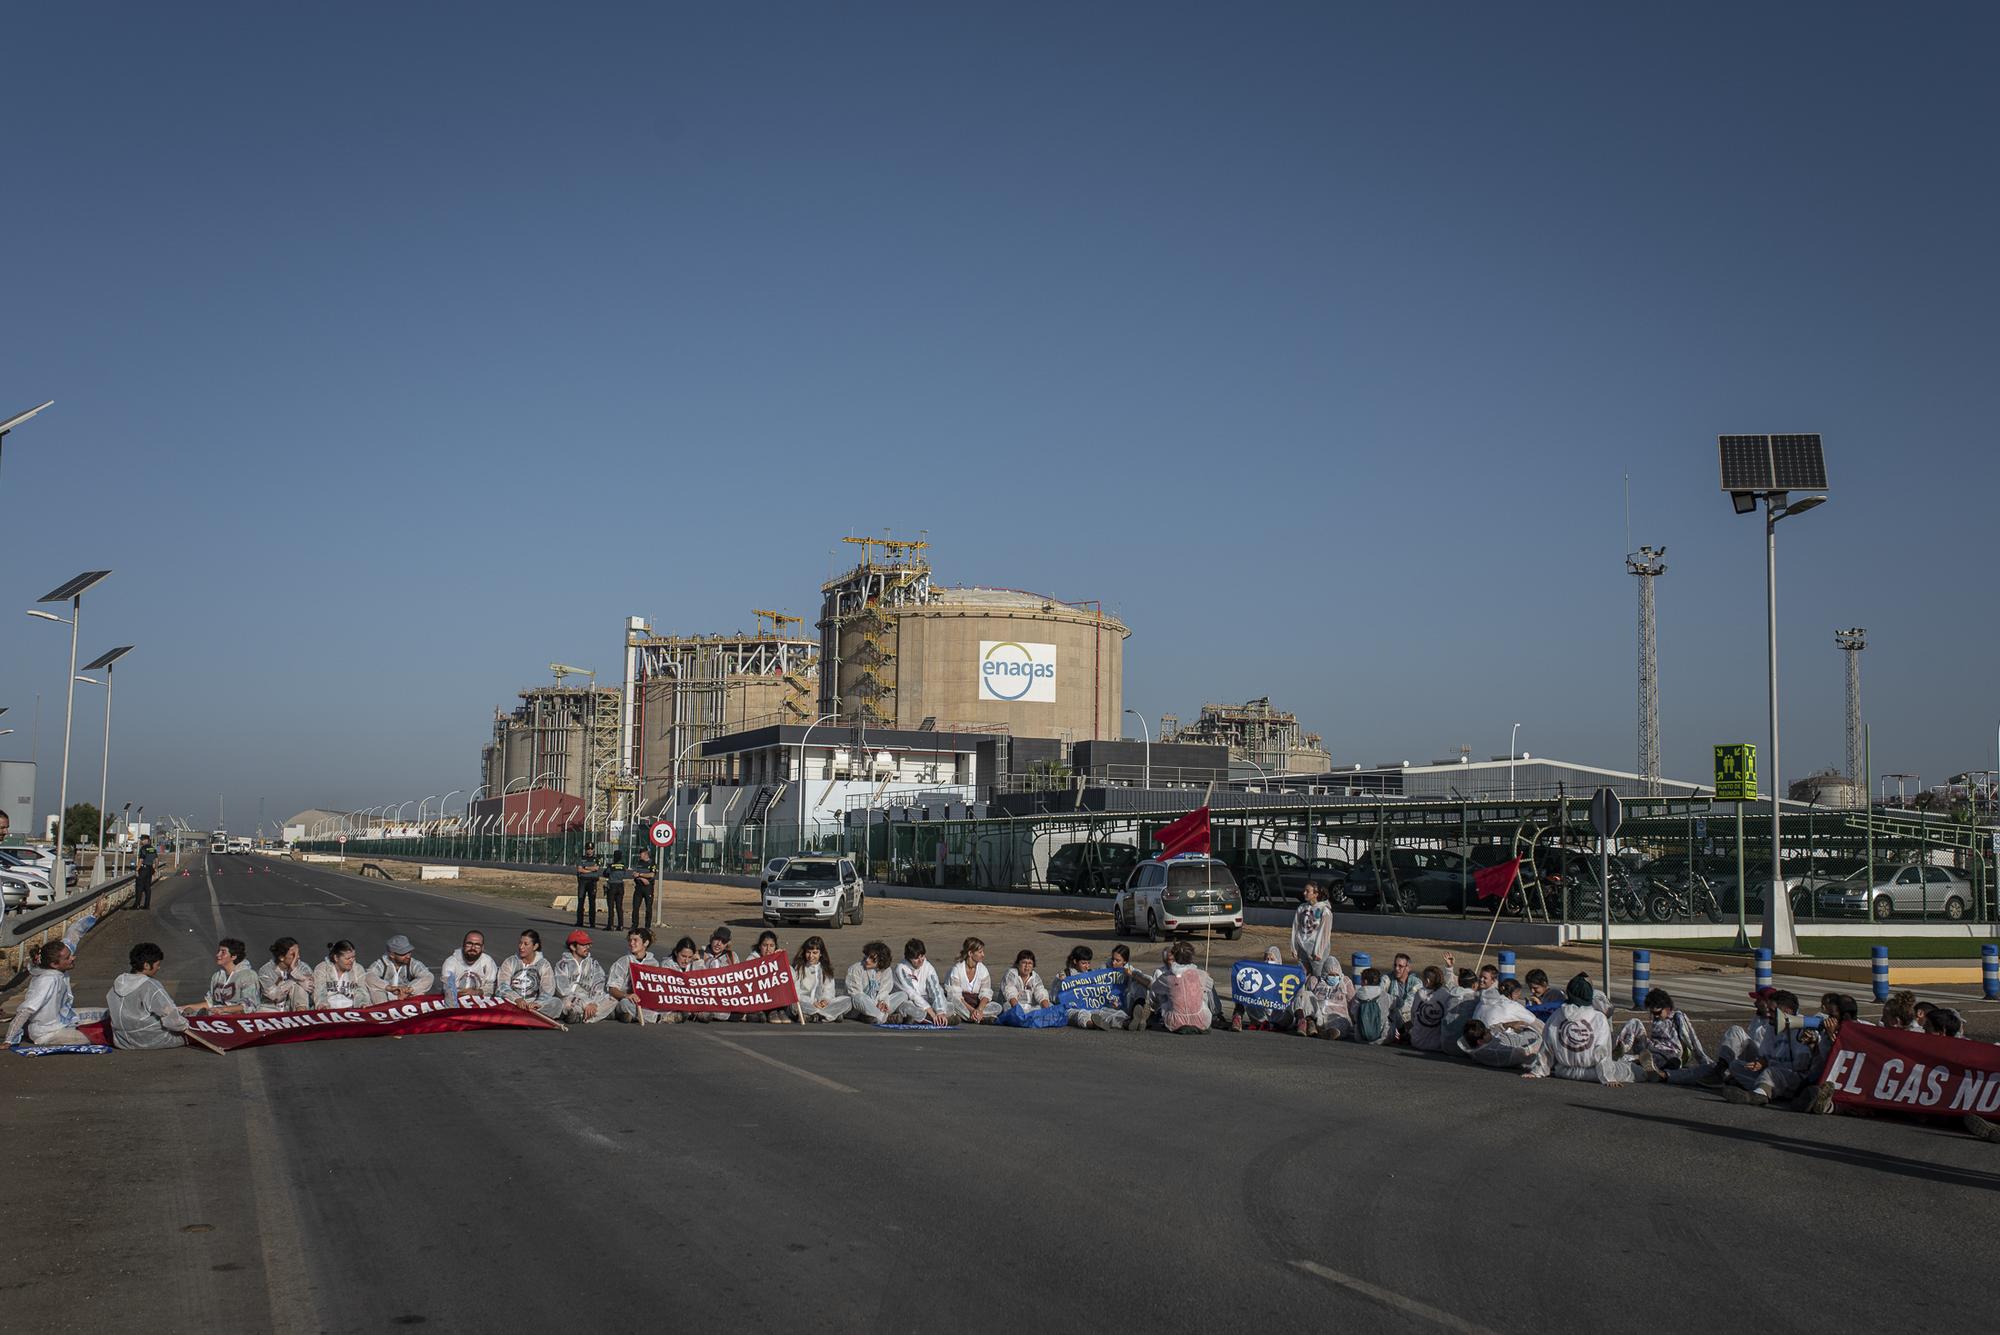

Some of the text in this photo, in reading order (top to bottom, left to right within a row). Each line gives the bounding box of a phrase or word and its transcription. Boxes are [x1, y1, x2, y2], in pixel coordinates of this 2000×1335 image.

[982, 660, 1054, 678] enagas
[656, 829, 670, 838] 60
[635, 971, 790, 997] A LA INDUSTRIA Y MÁS
[639, 960, 779, 987] MENOS SUBVENCIÓN
[658, 992, 773, 1007] JUSTICIA SOCIAL
[236, 1011, 366, 1034] FAMILIAS
[1826, 1049, 2000, 1113] EL GAS NO
